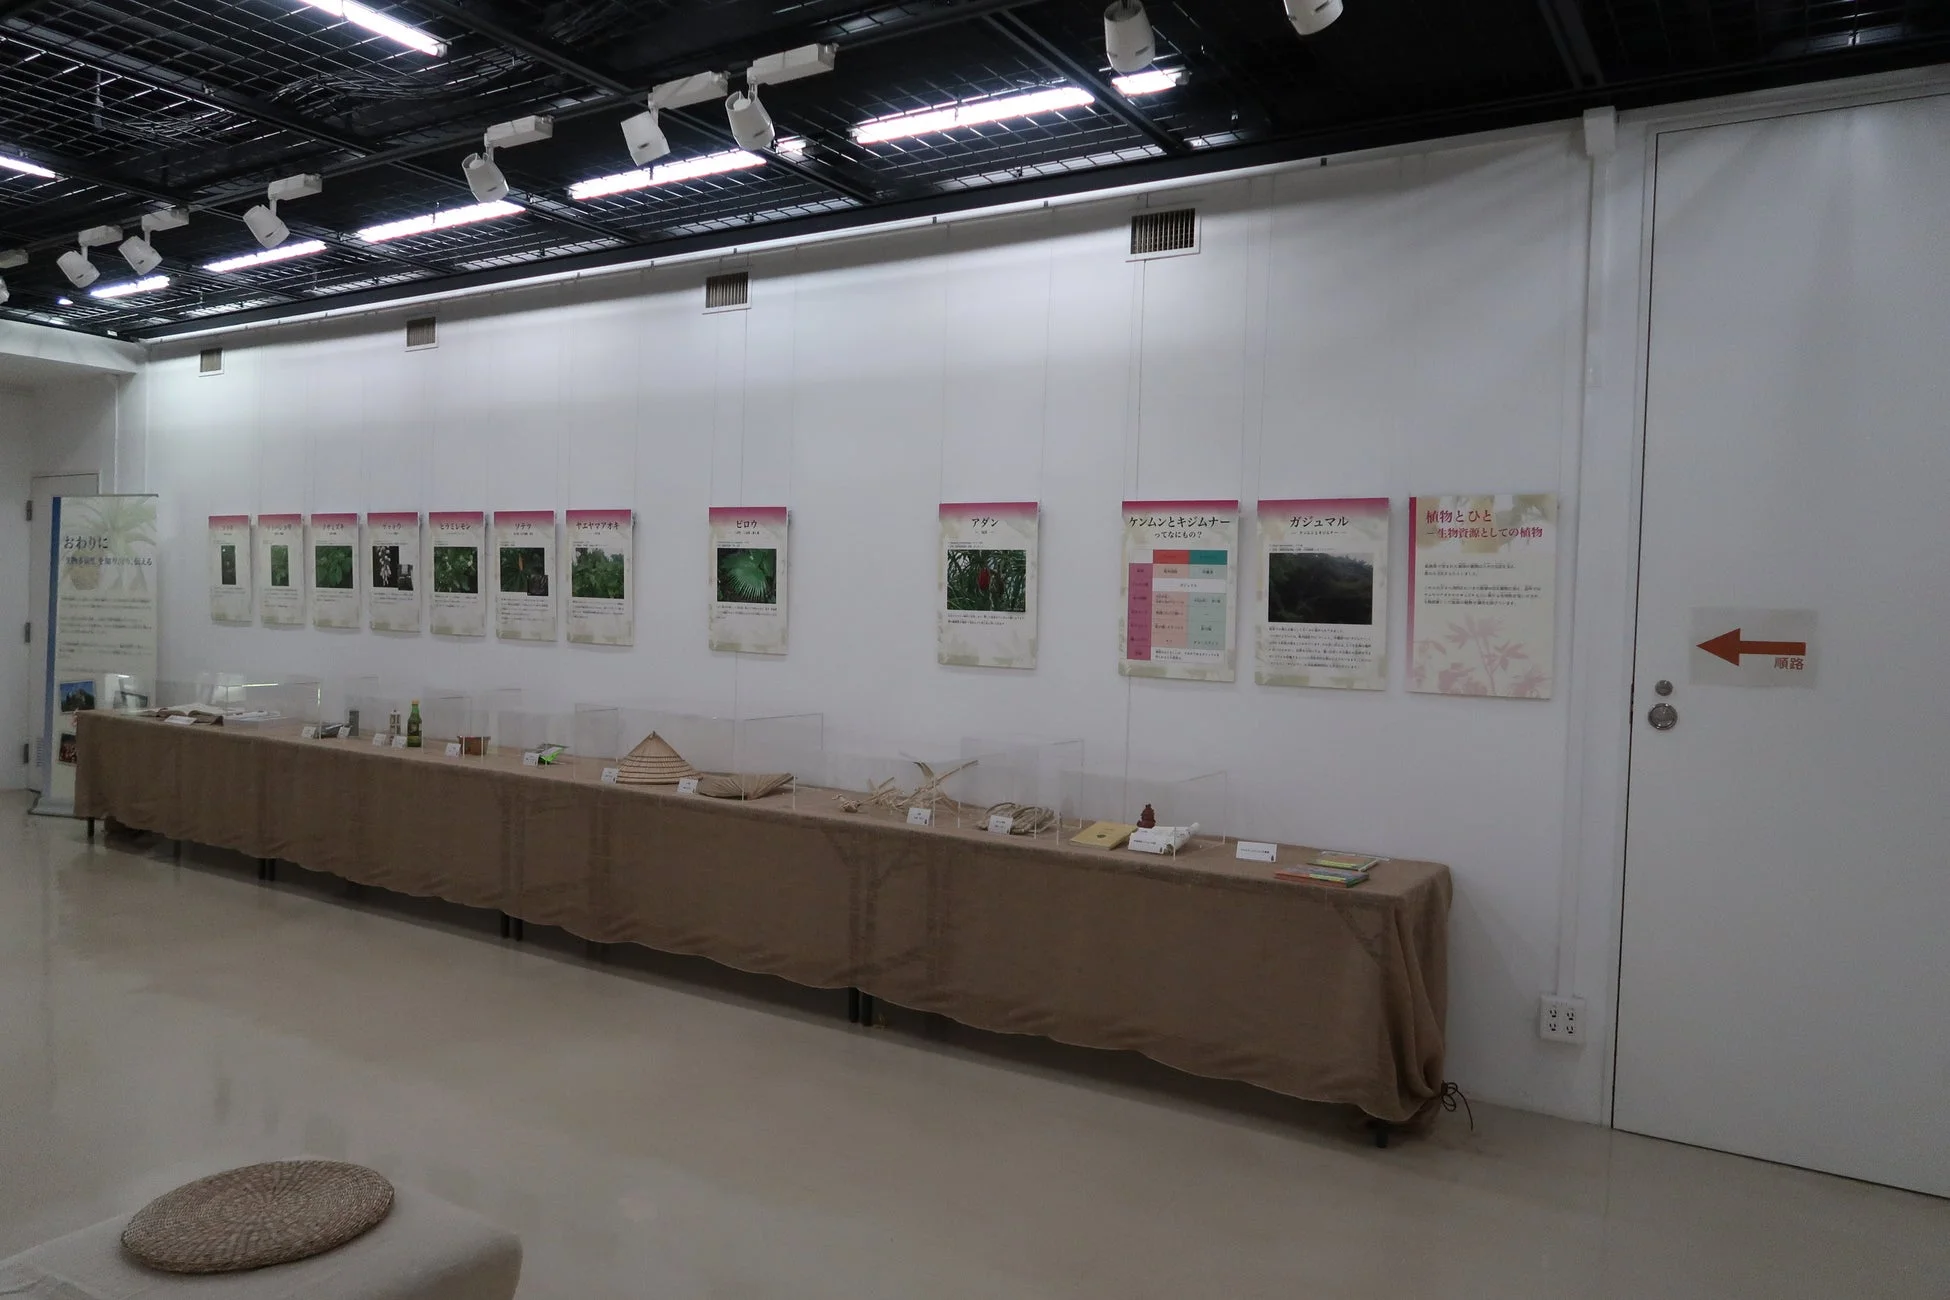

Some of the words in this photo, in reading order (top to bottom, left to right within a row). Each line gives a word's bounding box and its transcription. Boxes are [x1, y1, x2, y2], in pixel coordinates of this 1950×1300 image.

[971, 516, 1000, 528] アダン
[1128, 516, 1231, 529] ケンムンとキジムナー
[1289, 515, 1349, 528] ガジュマル
[1426, 510, 1493, 524] 植物とひと
[64, 535, 109, 550] おわりに
[1773, 657, 1804, 670] 順路
